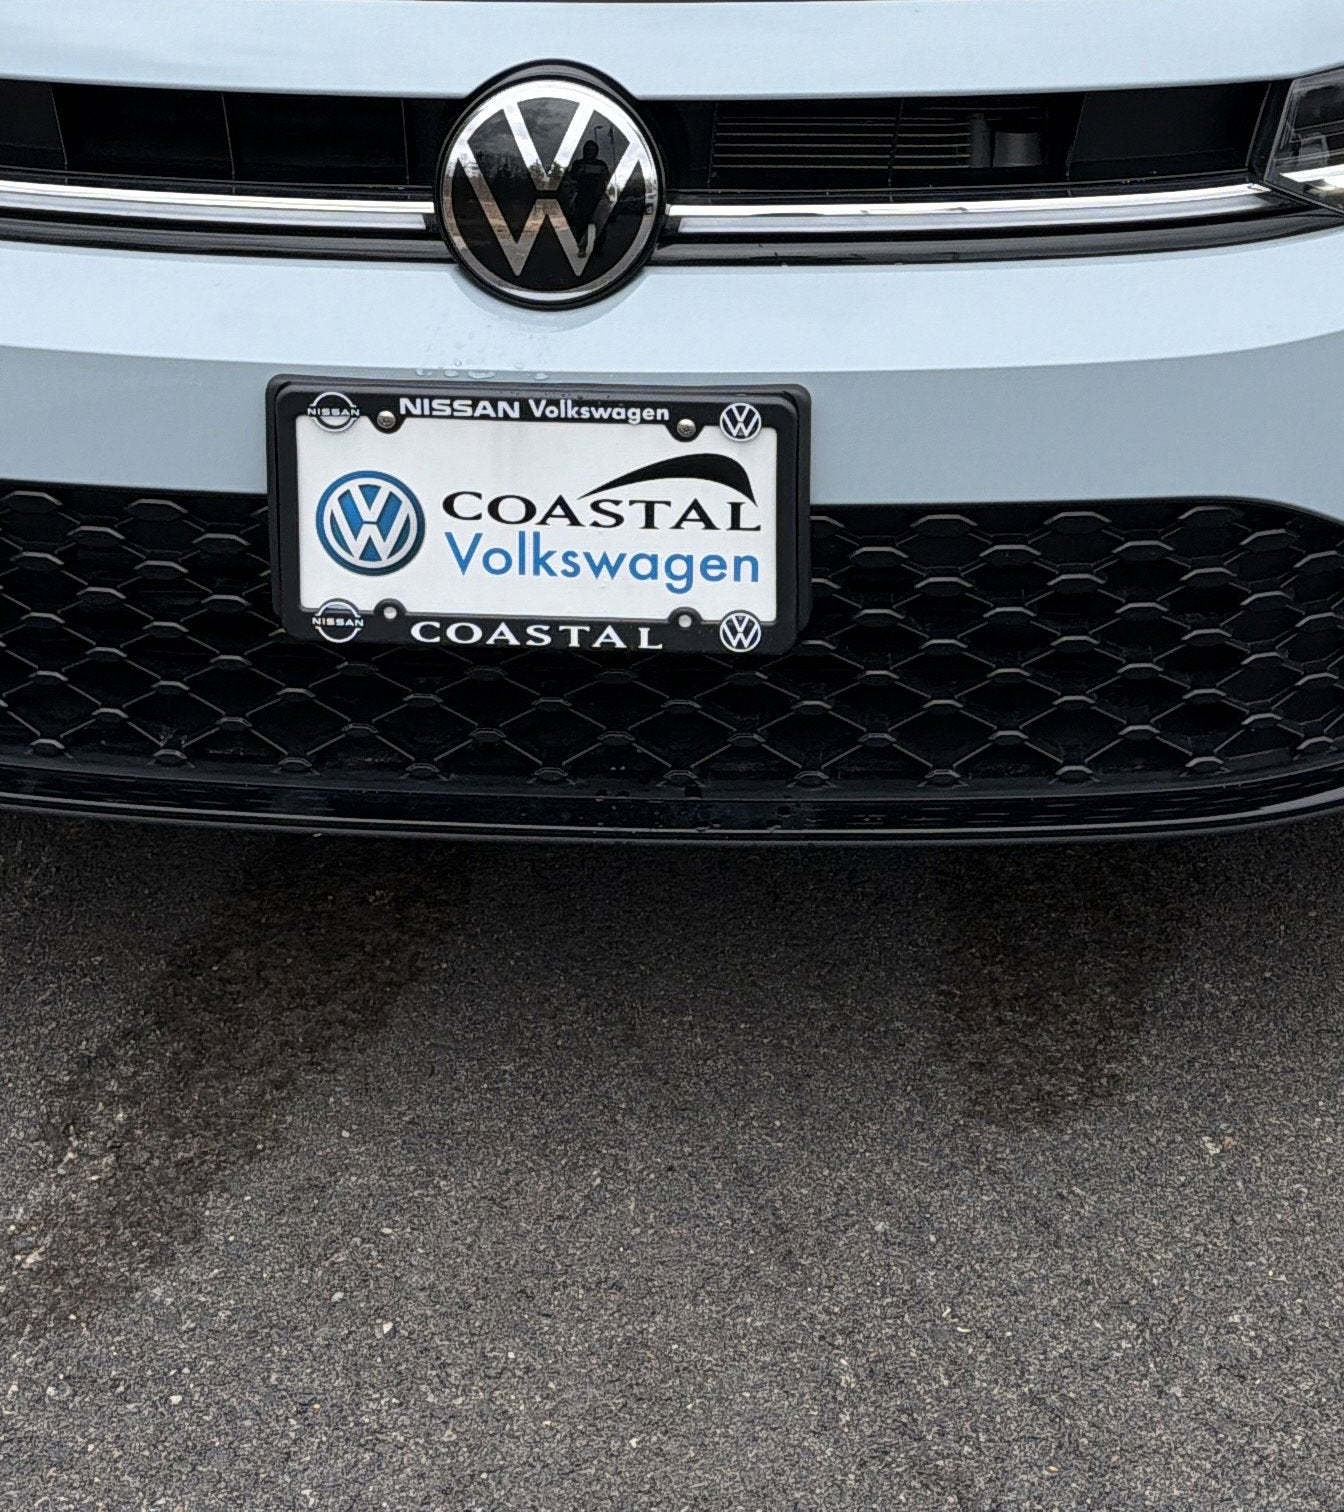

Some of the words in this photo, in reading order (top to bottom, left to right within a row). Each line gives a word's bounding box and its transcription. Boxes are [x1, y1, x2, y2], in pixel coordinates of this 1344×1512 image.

[306, 406, 360, 417] NISSAN
[399, 397, 520, 419] NISSAN
[528, 398, 669, 425] Volkswagen
[441, 490, 761, 532] COASTAL
[444, 530, 759, 595] Volkswagen
[311, 616, 364, 627] NISSAN
[410, 621, 663, 650] COASTAL
